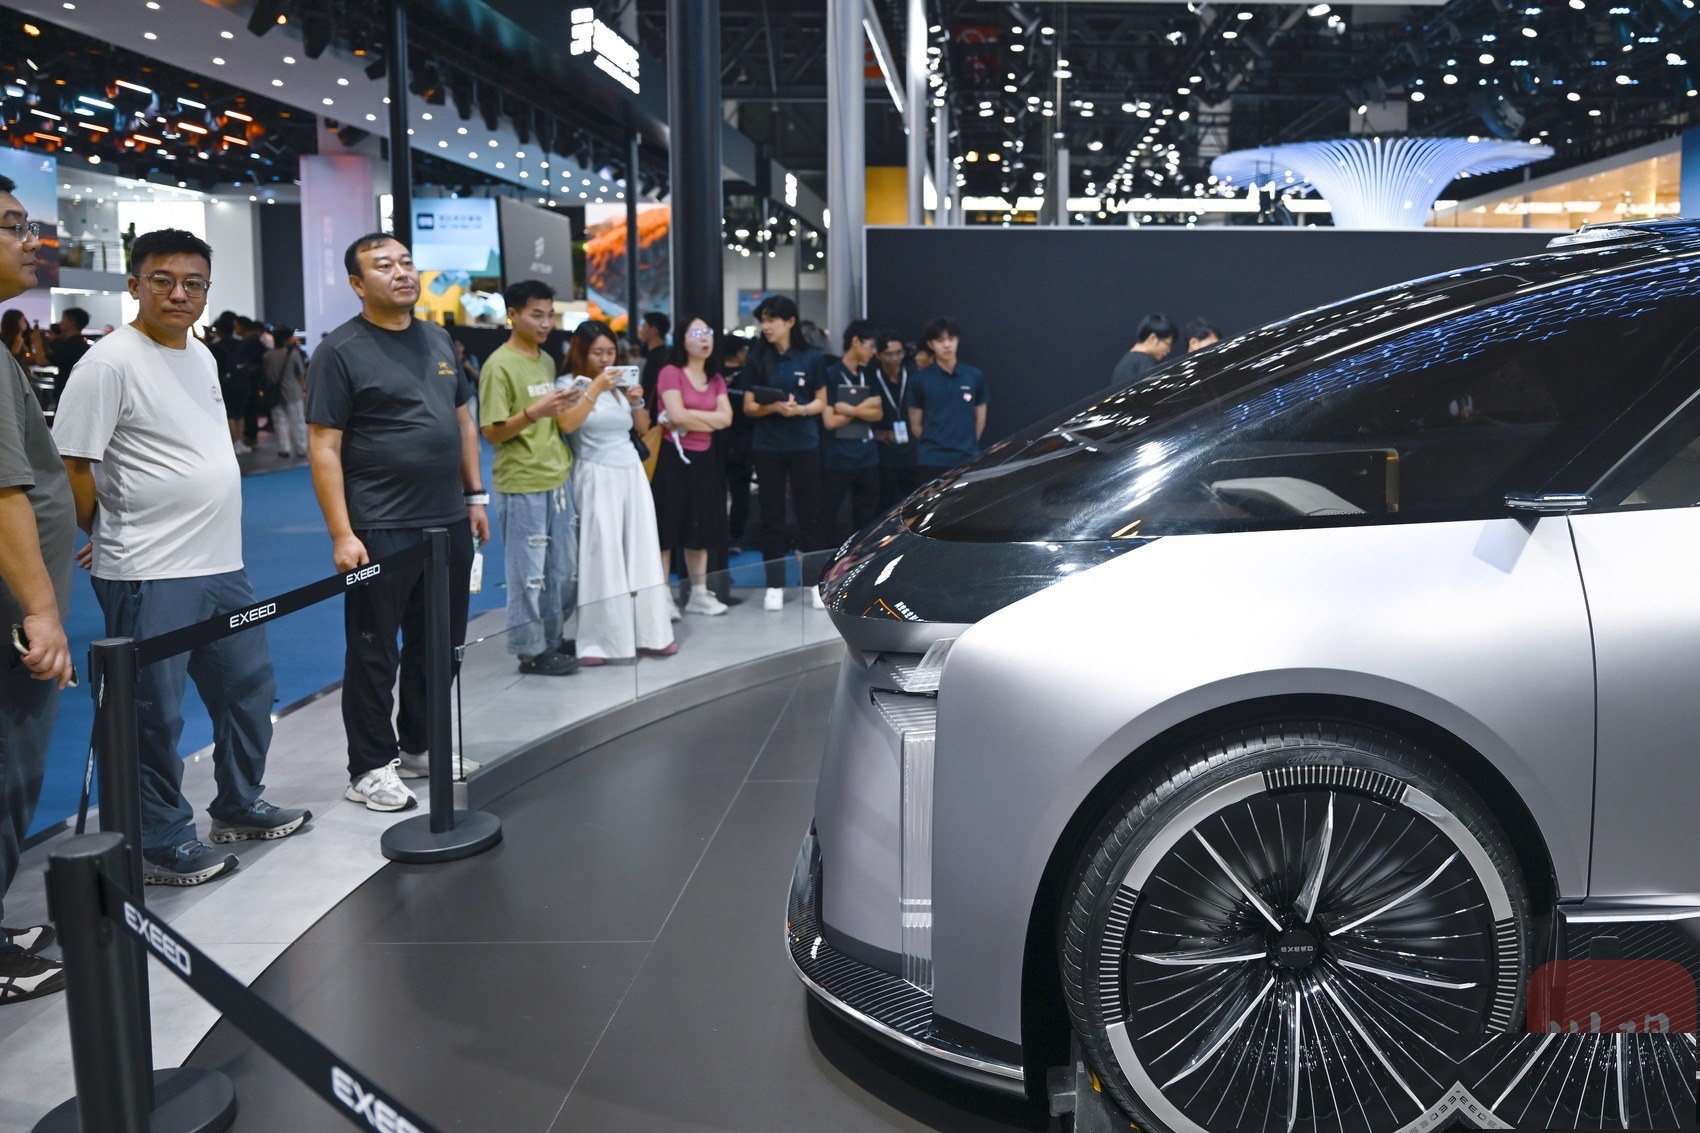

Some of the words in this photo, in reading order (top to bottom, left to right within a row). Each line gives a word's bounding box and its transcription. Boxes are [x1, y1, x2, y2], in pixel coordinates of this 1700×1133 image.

[346, 564, 380, 585] EXEED
[229, 602, 276, 628] EXEED
[123, 901, 192, 976] EXEED
[1281, 945, 1313, 953] EXEED
